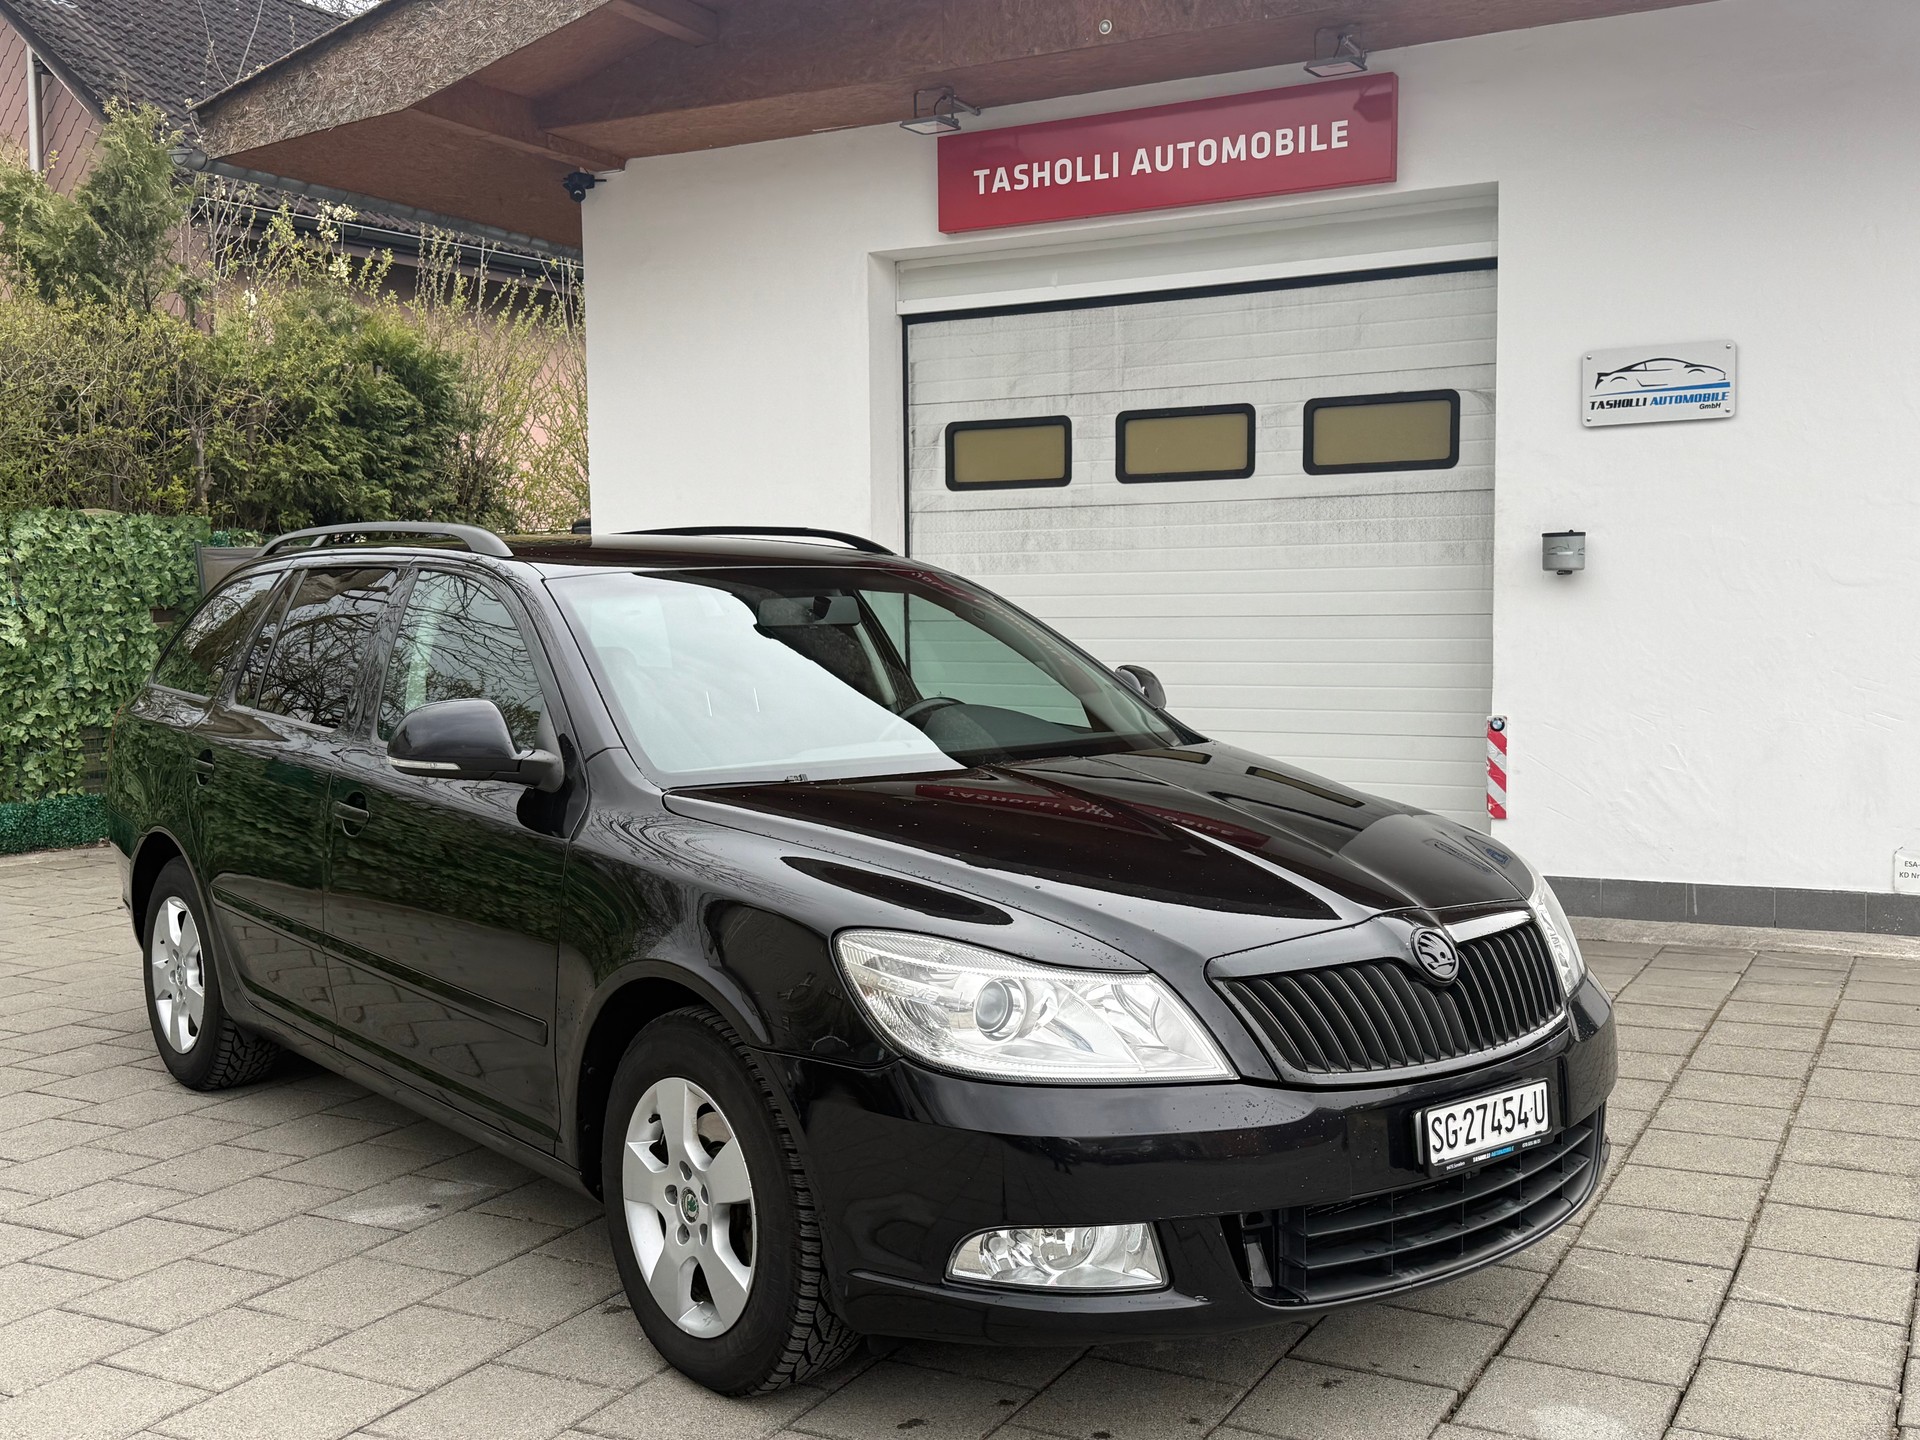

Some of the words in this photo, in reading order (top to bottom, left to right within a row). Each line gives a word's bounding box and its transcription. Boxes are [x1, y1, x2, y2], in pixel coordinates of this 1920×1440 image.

[973, 151, 1119, 195] TASHOLLI
[1130, 119, 1349, 176] AUTOMOBILE
[1590, 397, 1647, 410] TASHOLLI
[1650, 391, 1730, 406] AUTOMOBILE
[1699, 402, 1721, 411] GmbH
